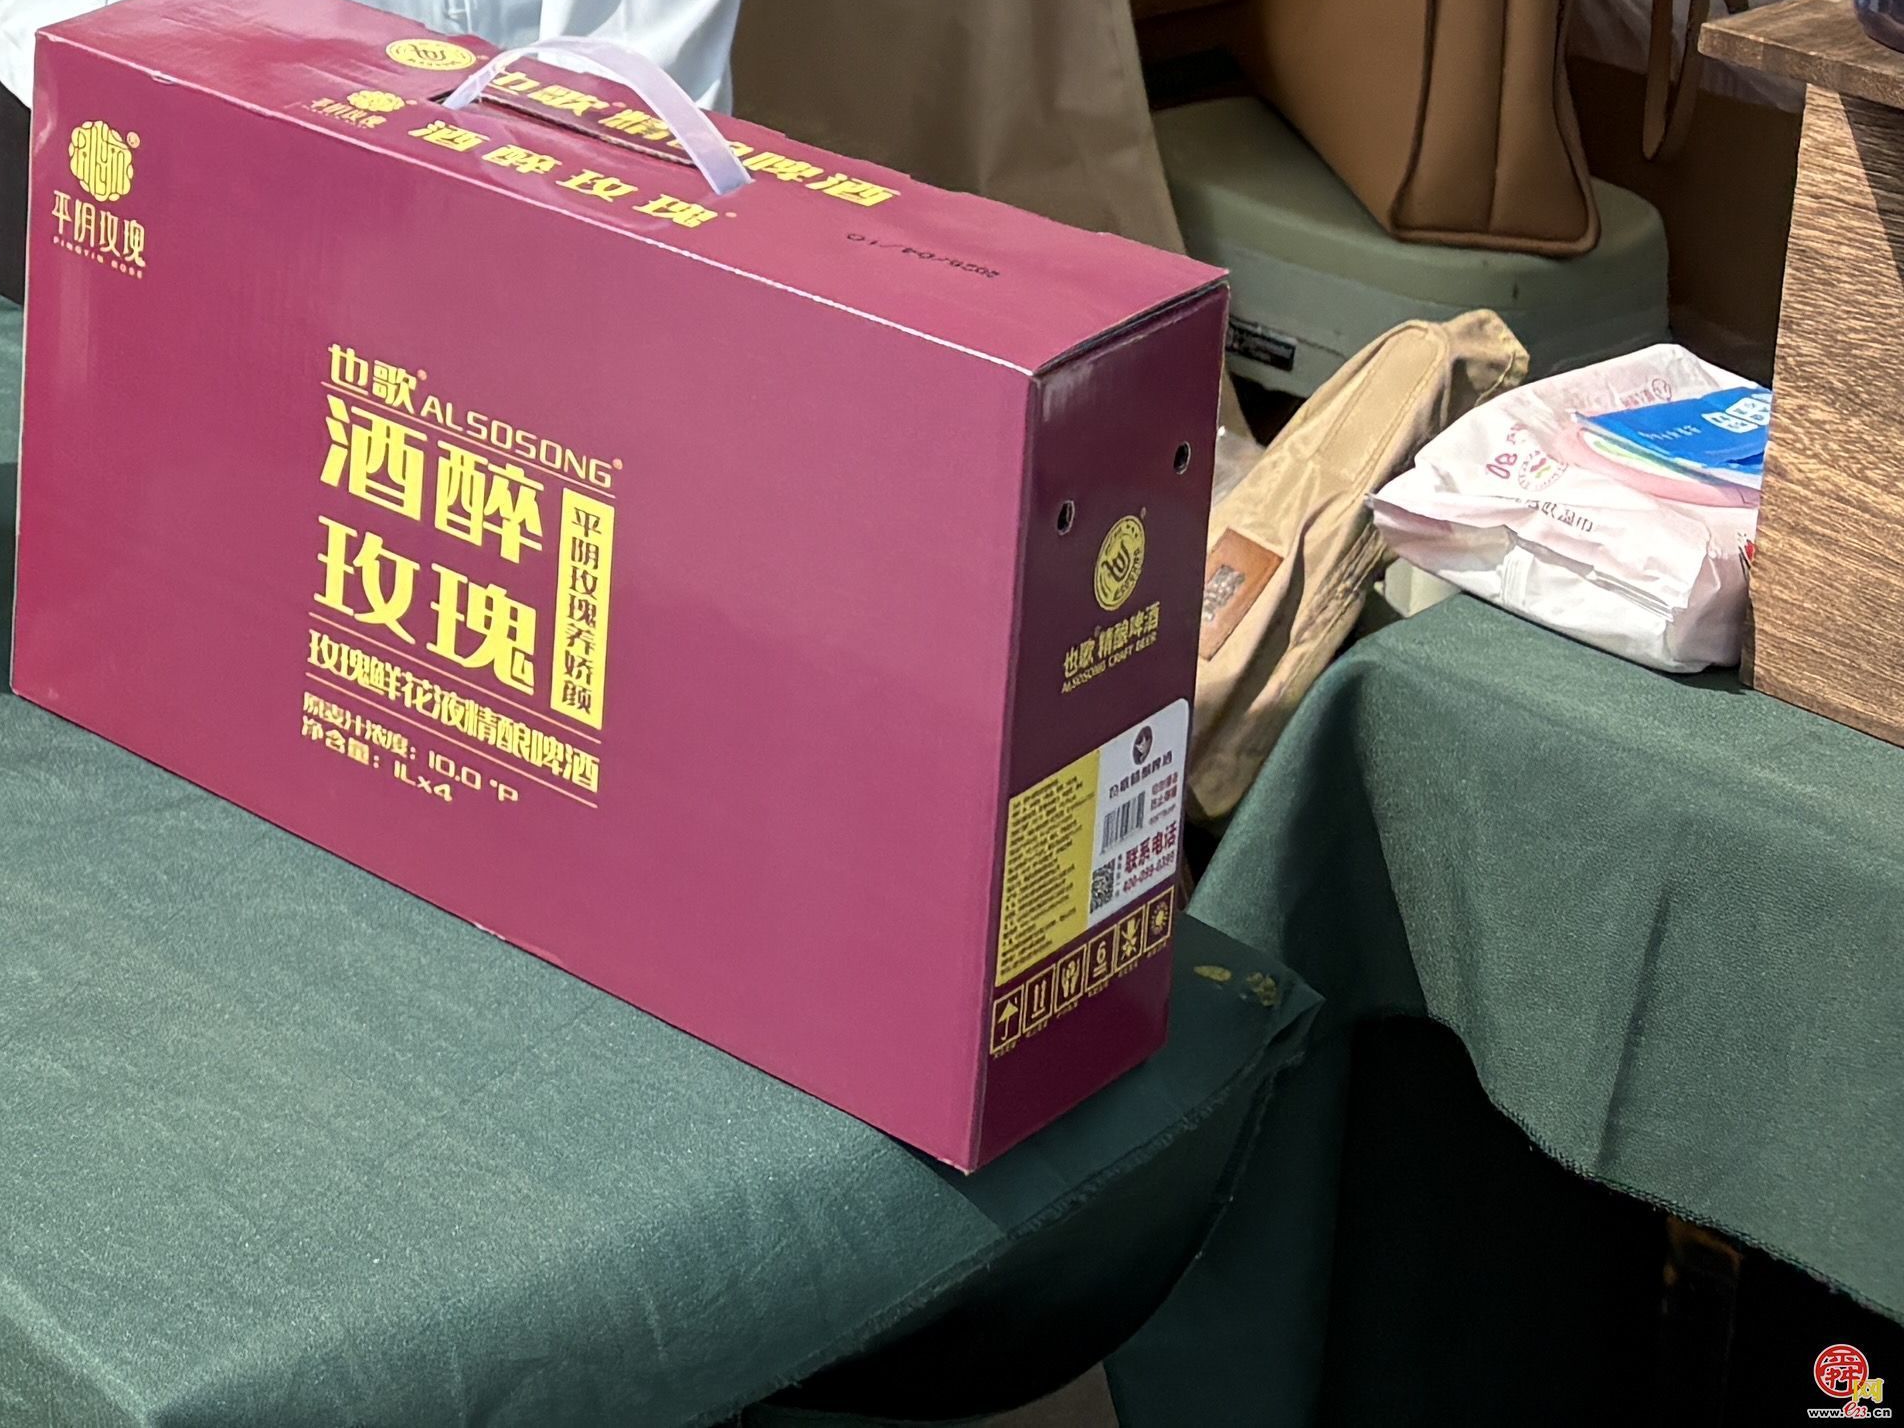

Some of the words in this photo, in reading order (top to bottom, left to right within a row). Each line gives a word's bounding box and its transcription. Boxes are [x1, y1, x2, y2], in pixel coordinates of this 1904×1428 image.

[408, 119, 719, 228] 酒醉玫瑰
[598, 104, 901, 208] 精啤酒
[51, 188, 146, 268] 平阴玫瑰
[320, 394, 544, 564] 酒醉
[328, 343, 418, 415] 也歌
[420, 395, 614, 489] ALSOSONG
[313, 515, 537, 696] 玫瑰
[561, 506, 604, 716] 平阴玫瑰养娇颜
[1063, 635, 1095, 680] 也歌
[307, 629, 599, 794] 玫瑰鲜花液精酿啤酒
[427, 749, 482, 790] 10.0
